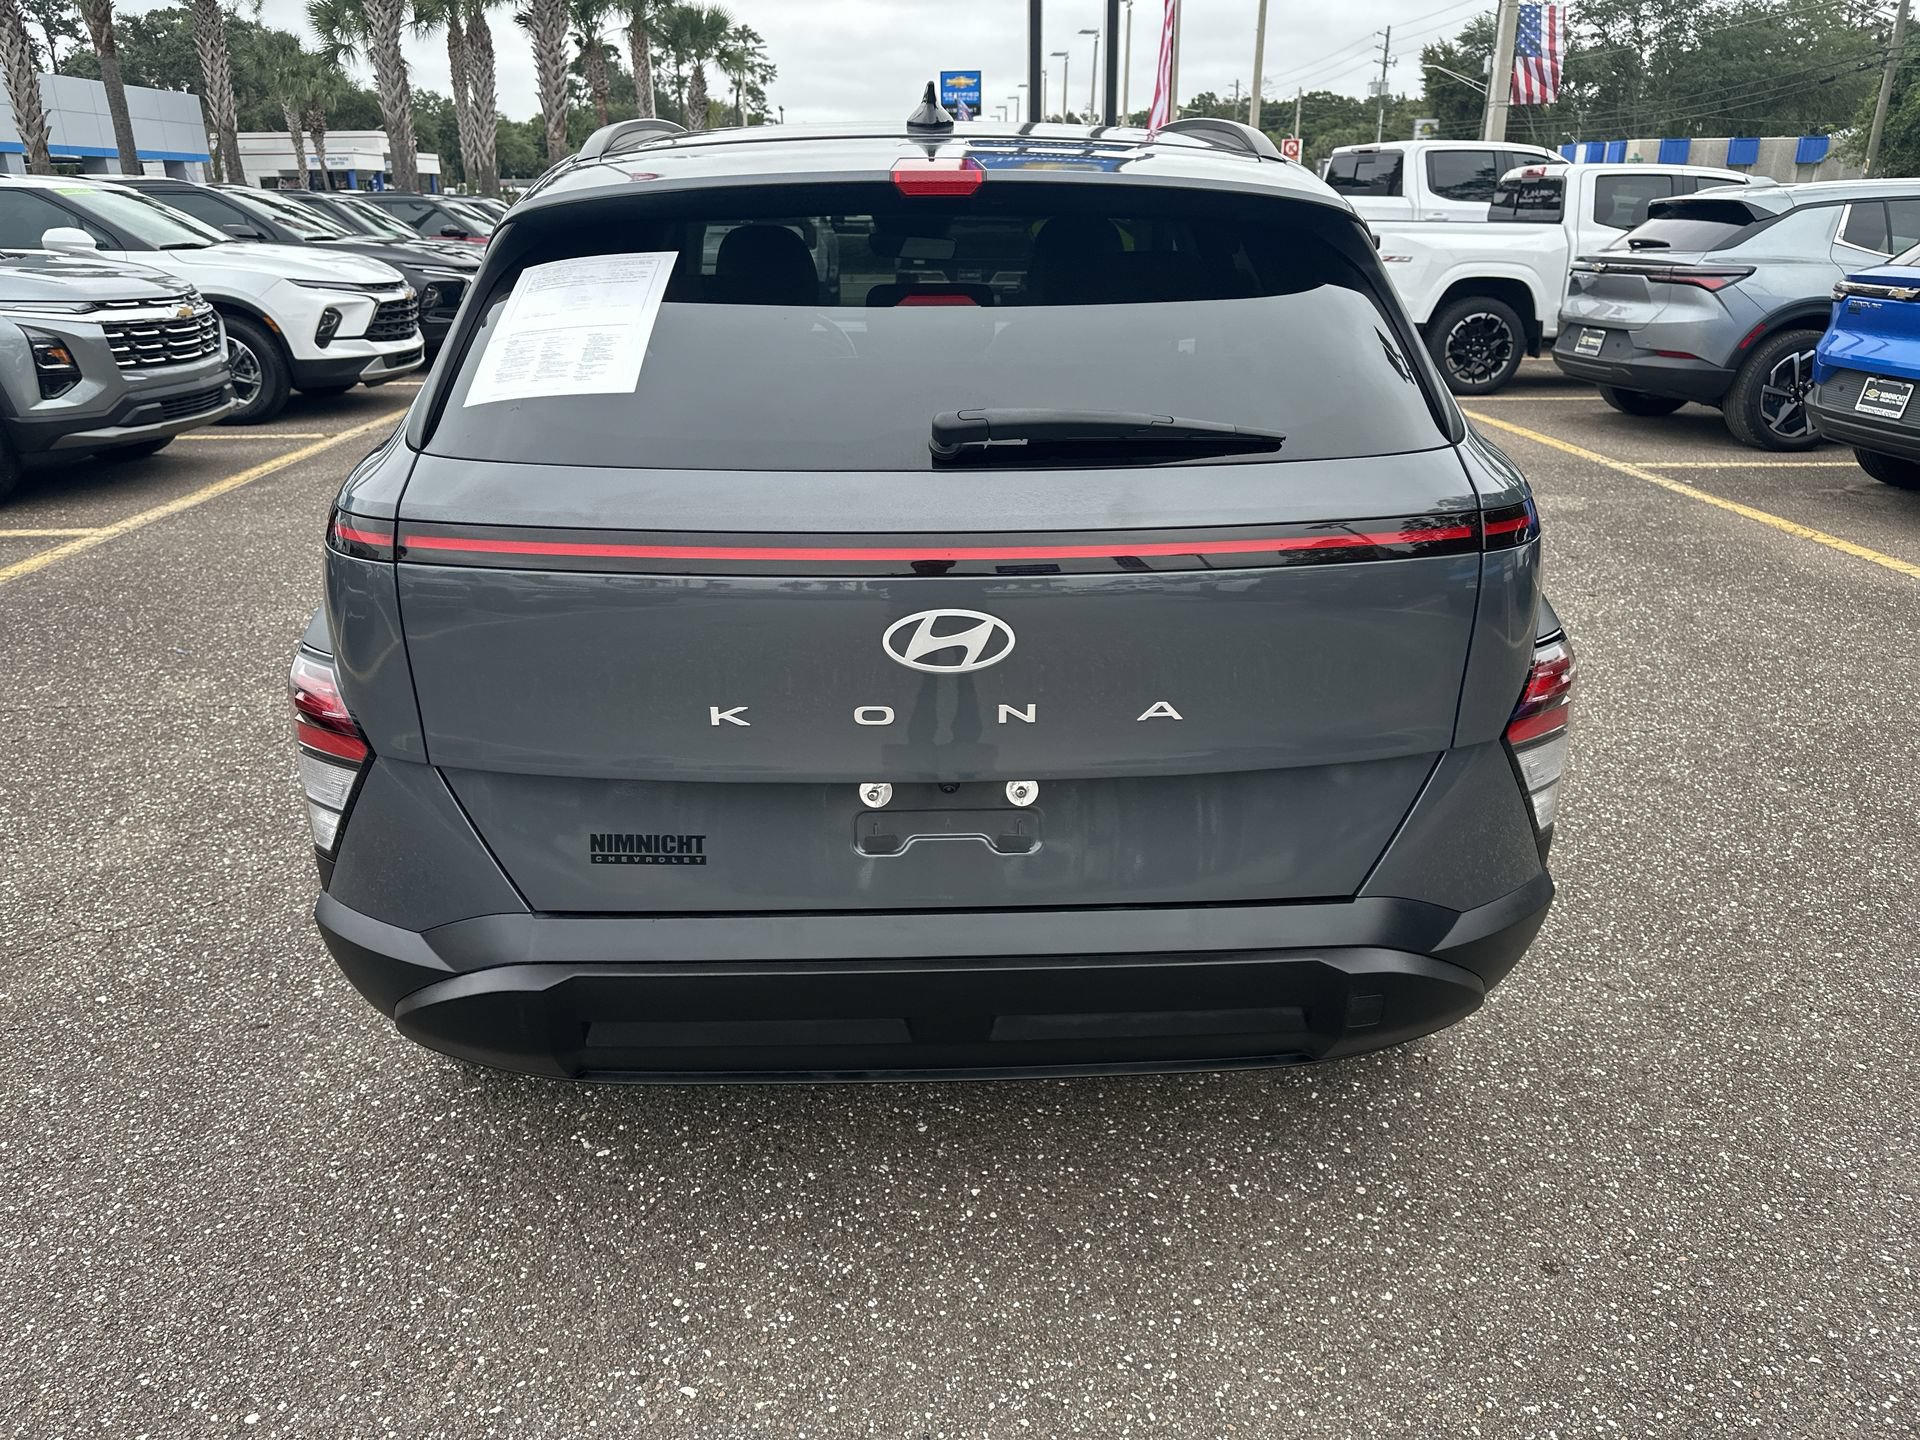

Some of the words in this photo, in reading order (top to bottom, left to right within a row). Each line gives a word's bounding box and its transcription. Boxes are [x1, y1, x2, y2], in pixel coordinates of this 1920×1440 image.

[709, 701, 1184, 727] KONA
[589, 833, 707, 854] NIMNICHT
[595, 855, 703, 864] CHEVROLET
